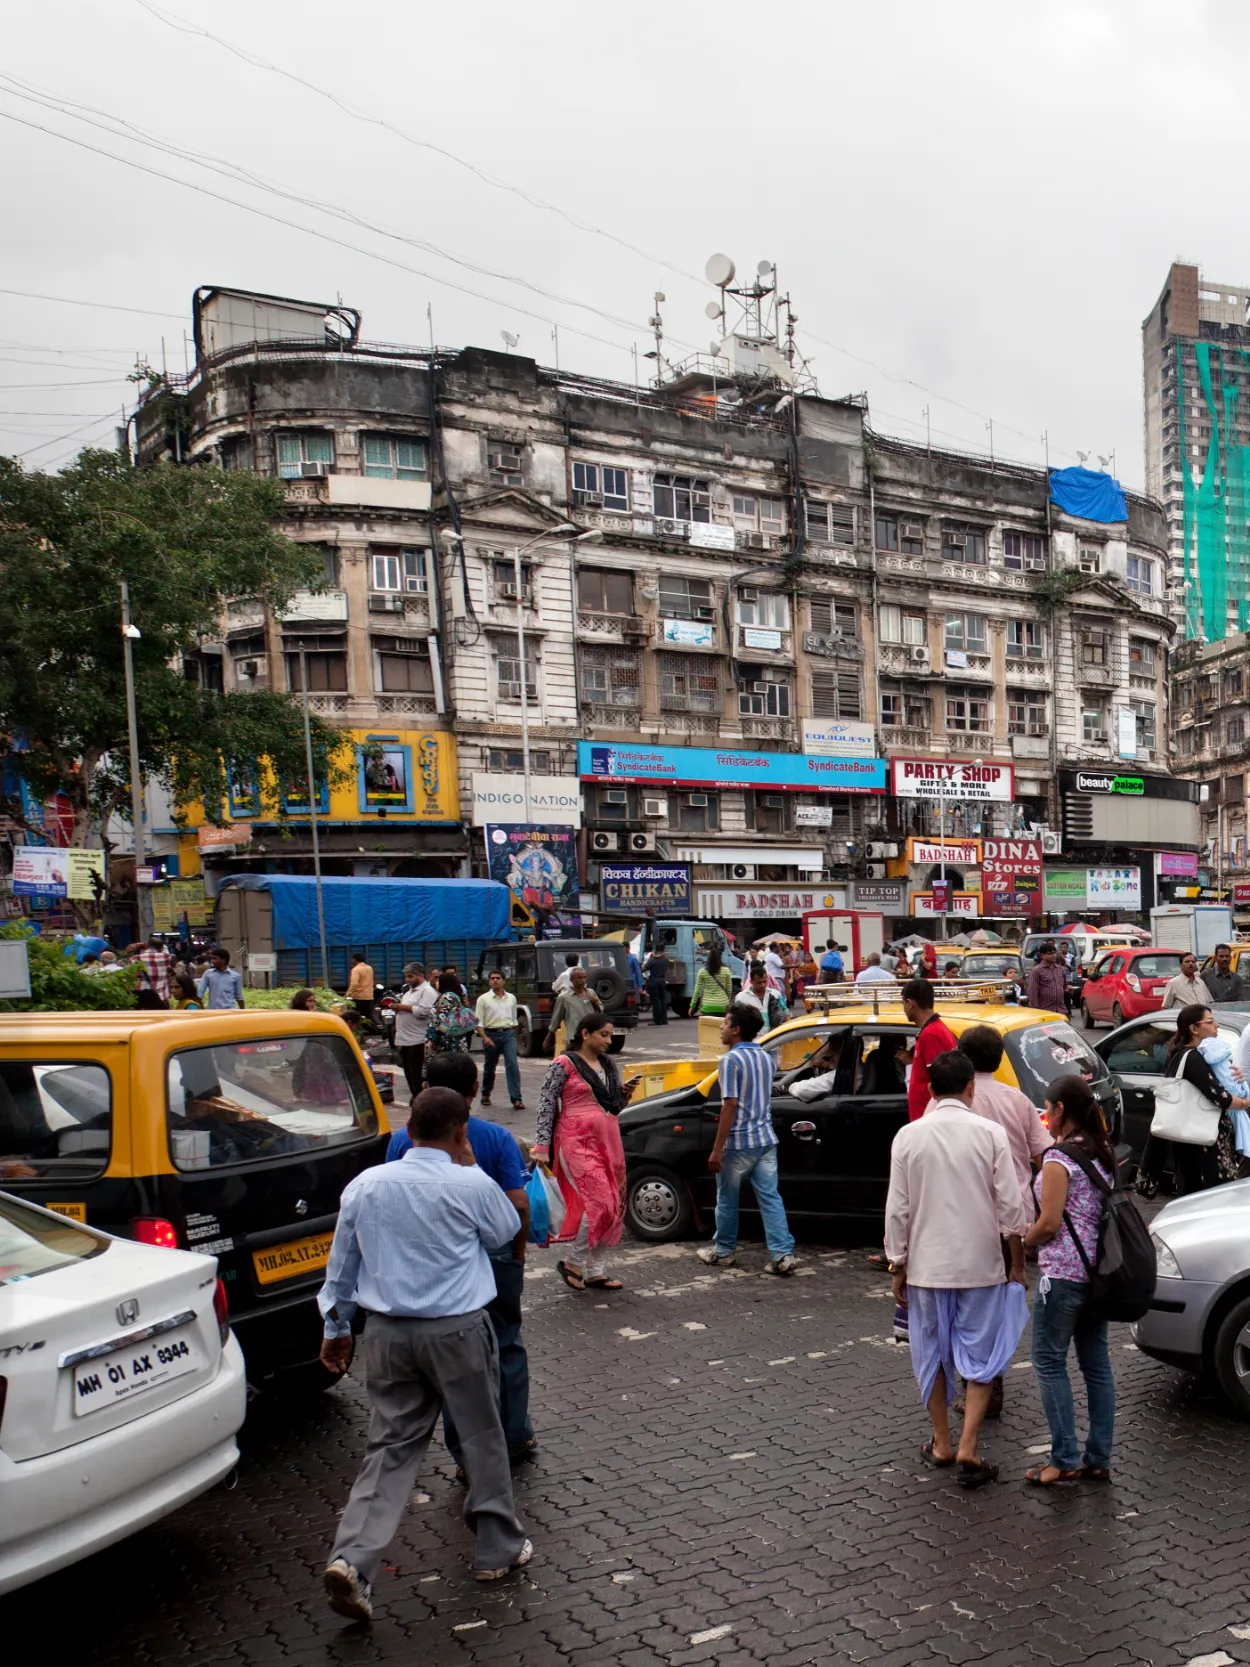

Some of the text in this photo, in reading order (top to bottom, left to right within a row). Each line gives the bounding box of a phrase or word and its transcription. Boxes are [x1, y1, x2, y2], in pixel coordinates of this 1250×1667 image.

[617, 762, 676, 773] SyndicateBank
[808, 760, 876, 773] SyndicateBank
[904, 763, 1001, 782] PARTY SHOP
[1080, 776, 1143, 791] beauty palace
[473, 793, 578, 806] INDIGO NATION
[919, 848, 972, 860] BADSHAH
[984, 841, 1040, 860] DINA
[983, 860, 1040, 874] Stores
[606, 883, 687, 898] CHIKAN
[736, 893, 814, 908] BADSHAH
[186, 1223, 220, 1236] MARUTI
[187, 1228, 220, 1241] SUZUKI
[77, 1374, 102, 1397] MH
[133, 1355, 153, 1375] AX
[157, 1341, 189, 1364] 8344
